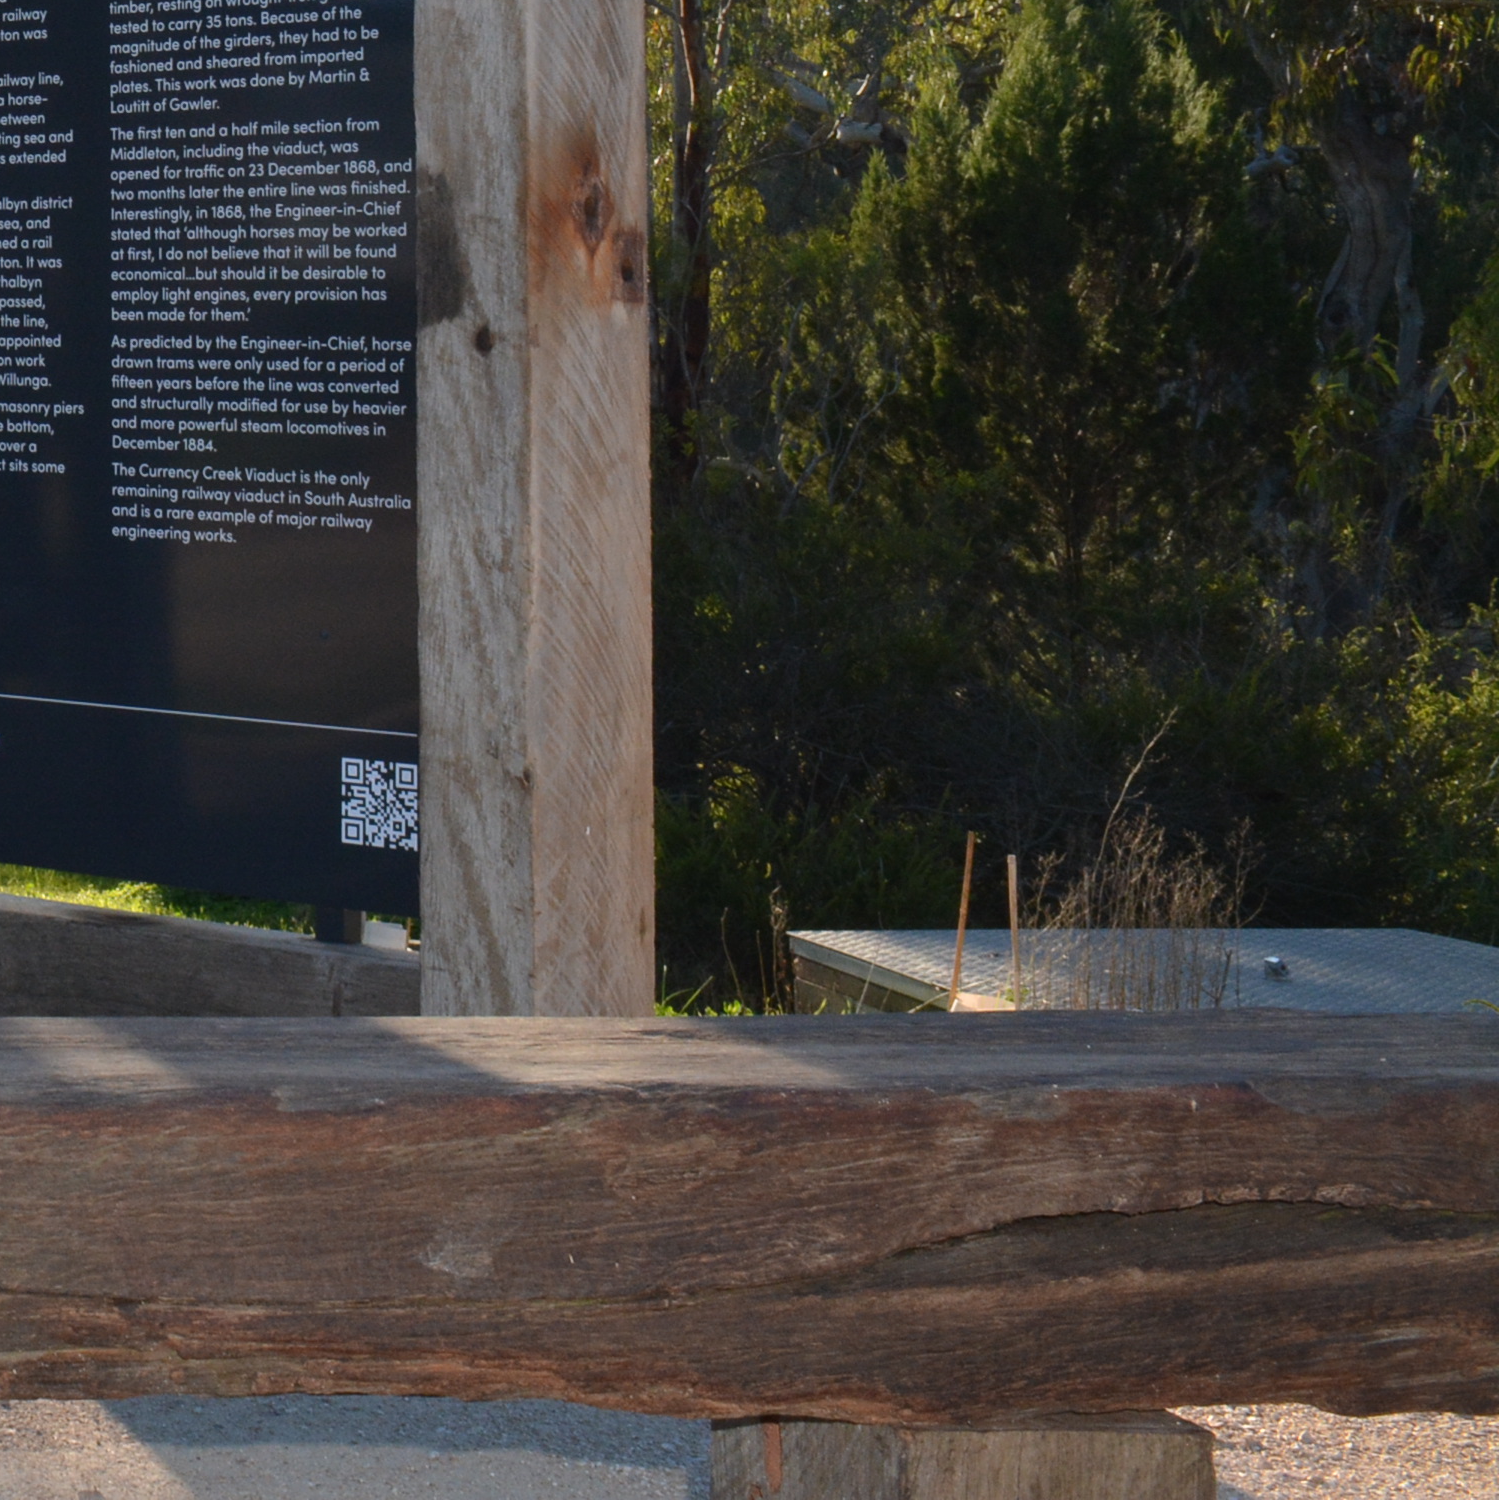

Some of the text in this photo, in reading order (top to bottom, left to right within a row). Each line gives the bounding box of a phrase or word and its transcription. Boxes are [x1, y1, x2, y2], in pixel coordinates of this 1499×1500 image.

[2, 7, 47, 23] railway
[110, 95, 220, 114] Loutitt of Gawler.
[21, 238, 29, 249] a
[33, 234, 52, 249] rail
[112, 433, 217, 452] December 1884.
[112, 483, 411, 509] remaining railway viaduct in South Australia
